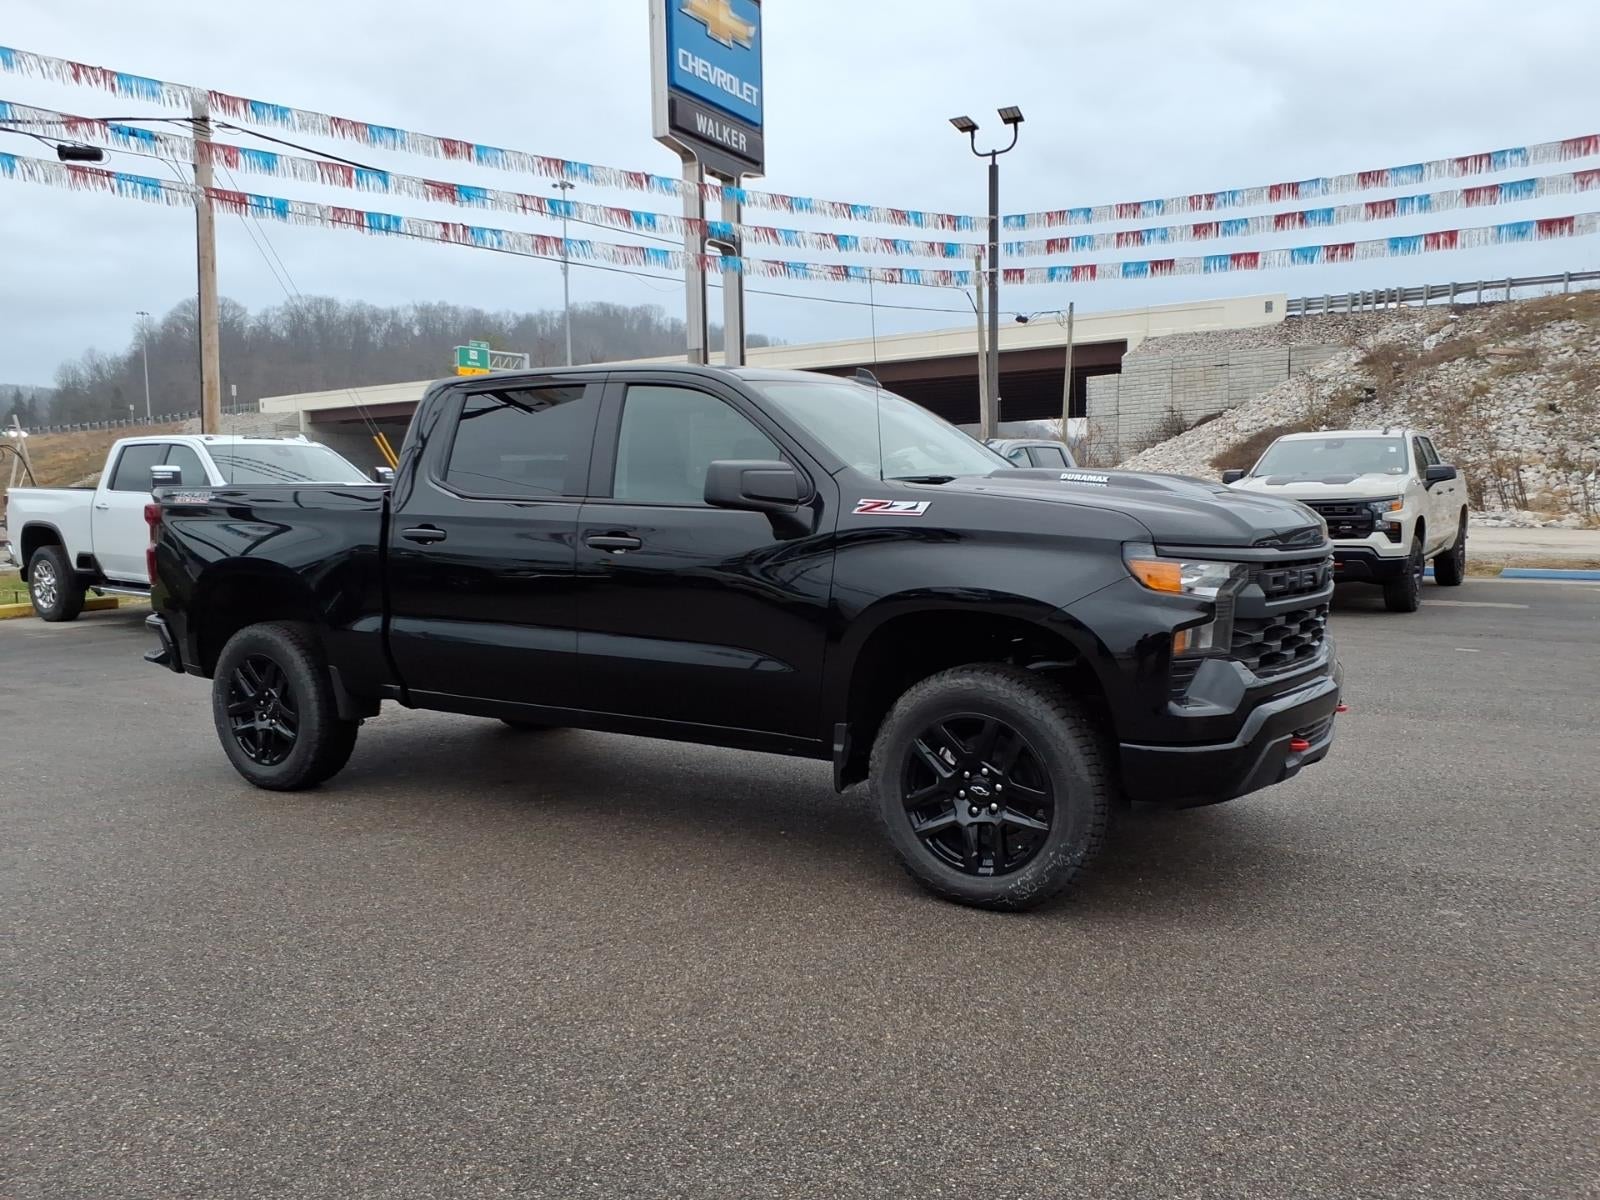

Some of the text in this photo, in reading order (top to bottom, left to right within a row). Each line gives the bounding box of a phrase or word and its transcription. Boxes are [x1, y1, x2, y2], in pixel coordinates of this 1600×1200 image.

[678, 48, 759, 106] CHEVROLET
[696, 112, 747, 153] WALKER
[1060, 473, 1109, 483] DURAMAX
[852, 498, 931, 516] Z71
